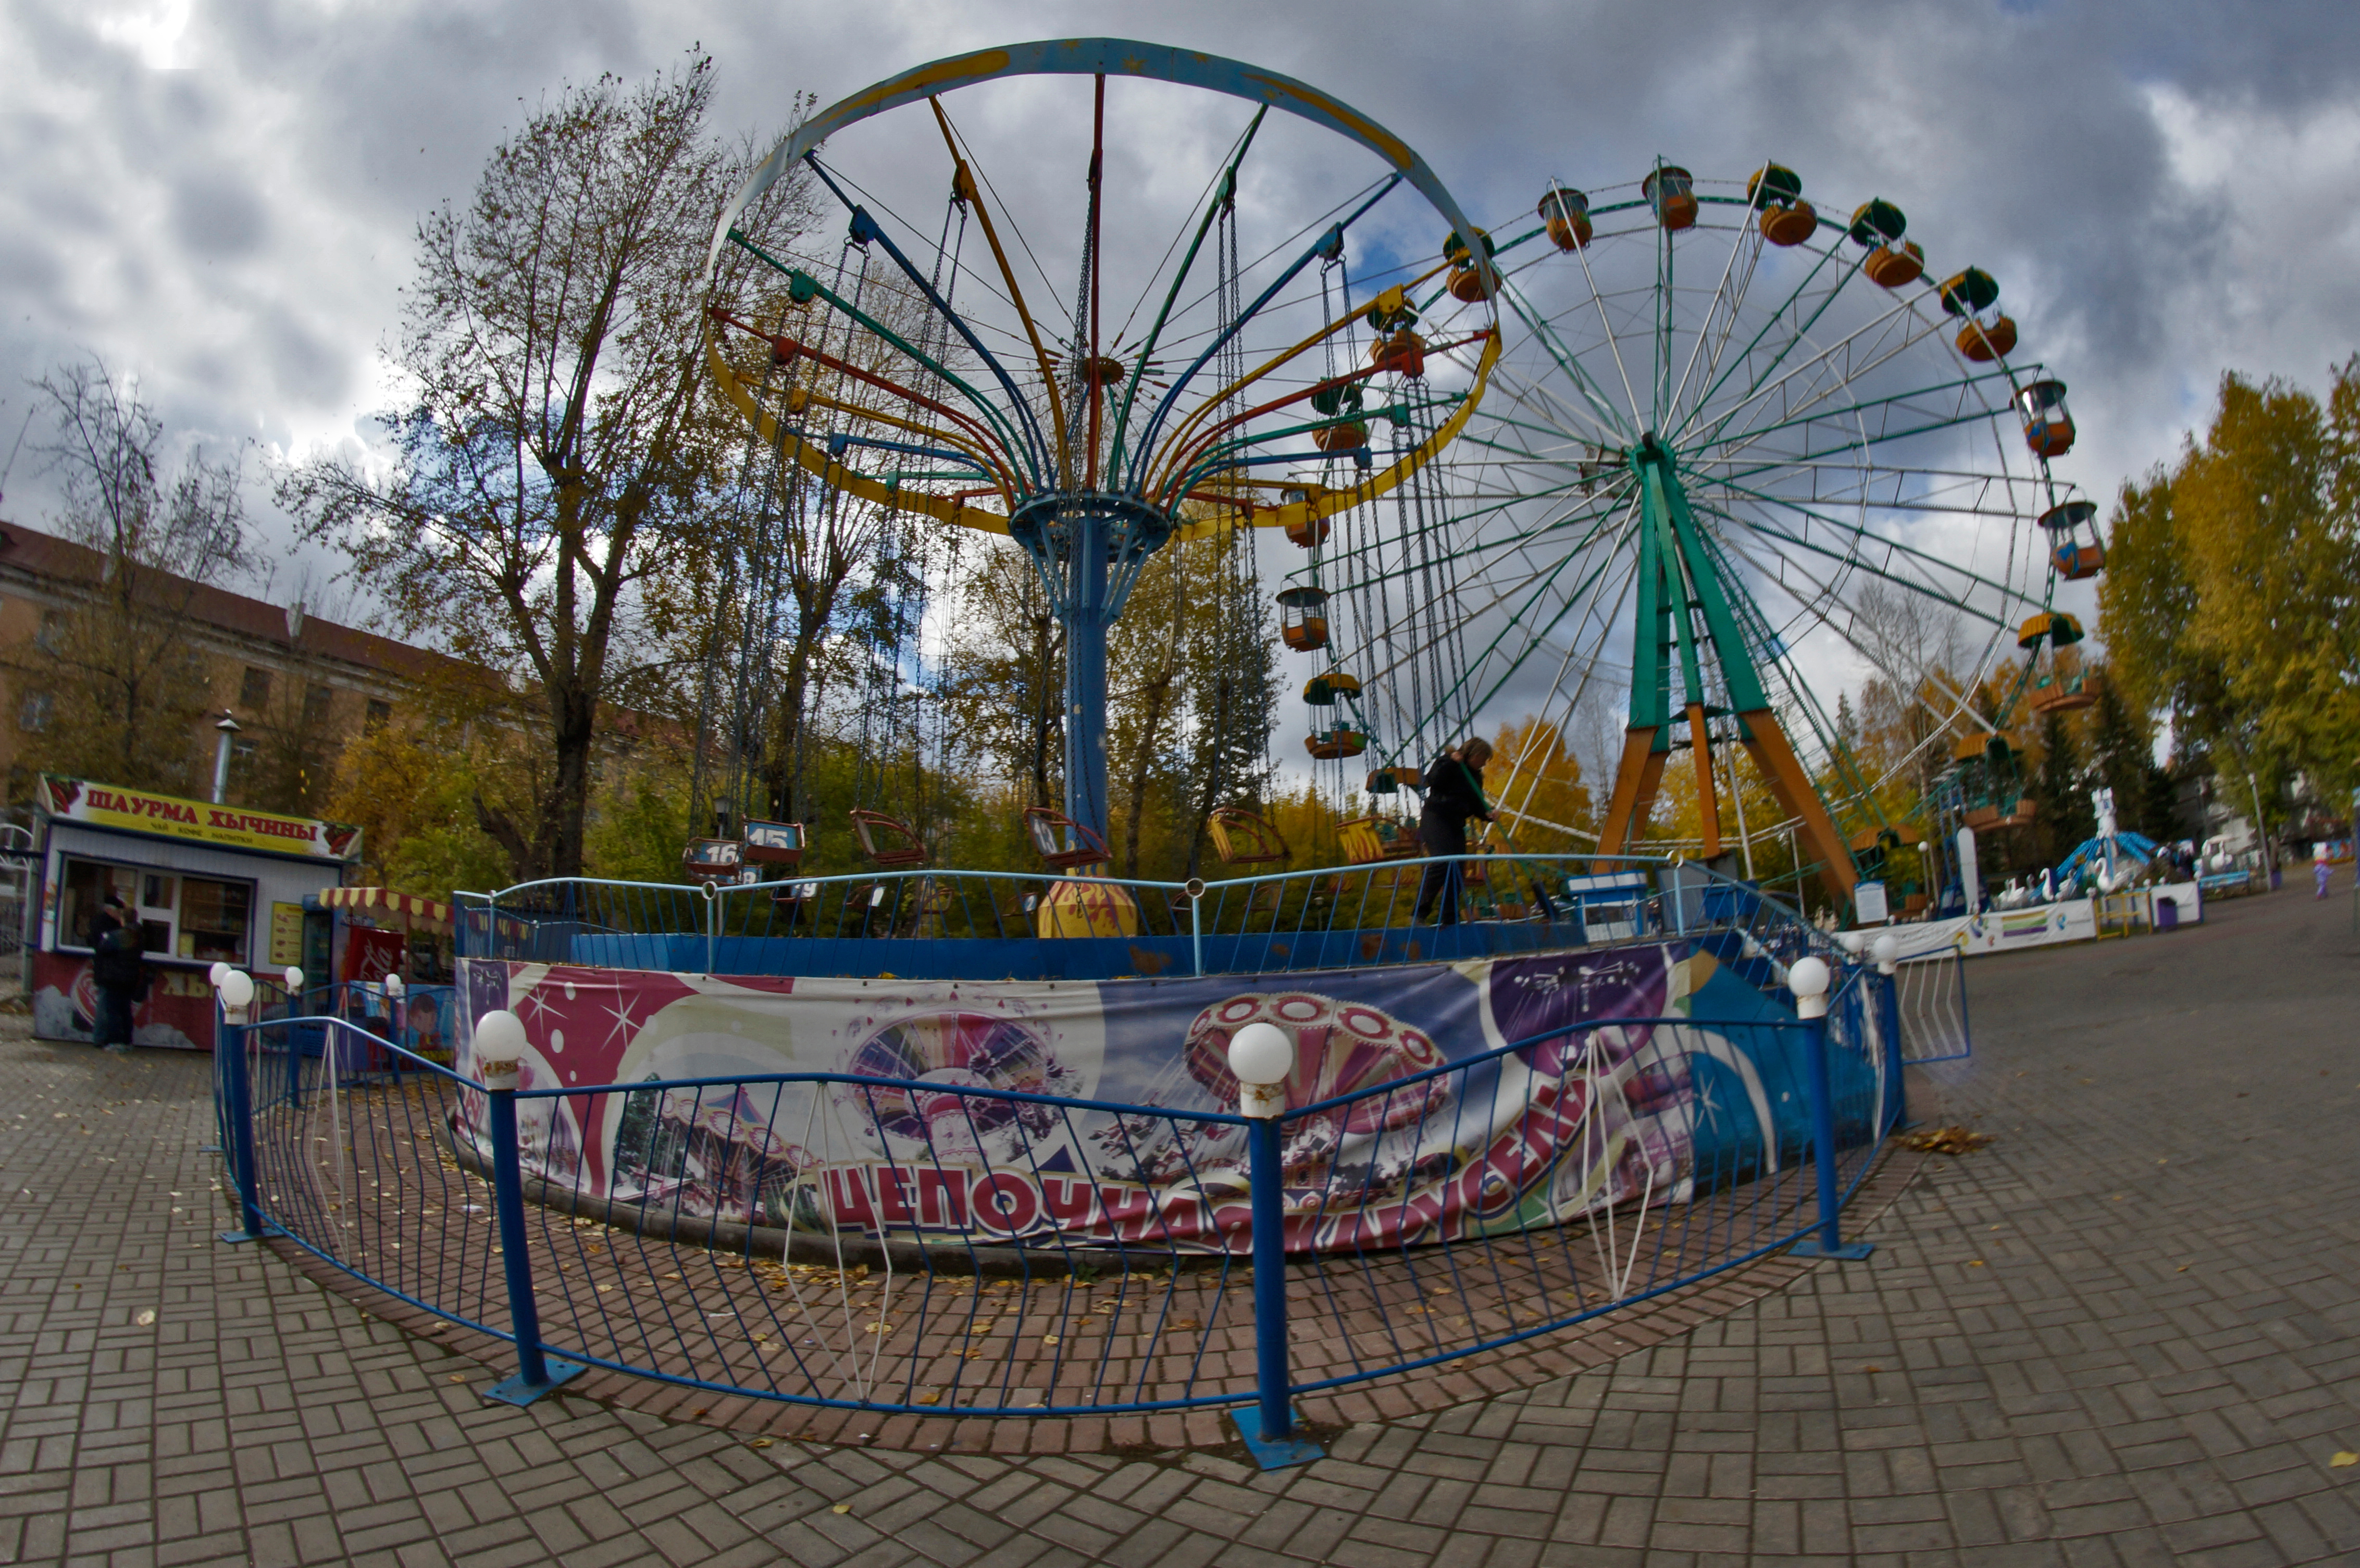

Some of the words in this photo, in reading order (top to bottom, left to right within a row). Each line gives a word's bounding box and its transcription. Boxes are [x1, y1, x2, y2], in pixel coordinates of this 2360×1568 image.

[86, 789, 198, 824] ШАУРМА
[749, 827, 788, 849] 15
[706, 844, 738, 863] 16
[819, 1165, 1253, 1253] ЦЕПОЧНАЯ
